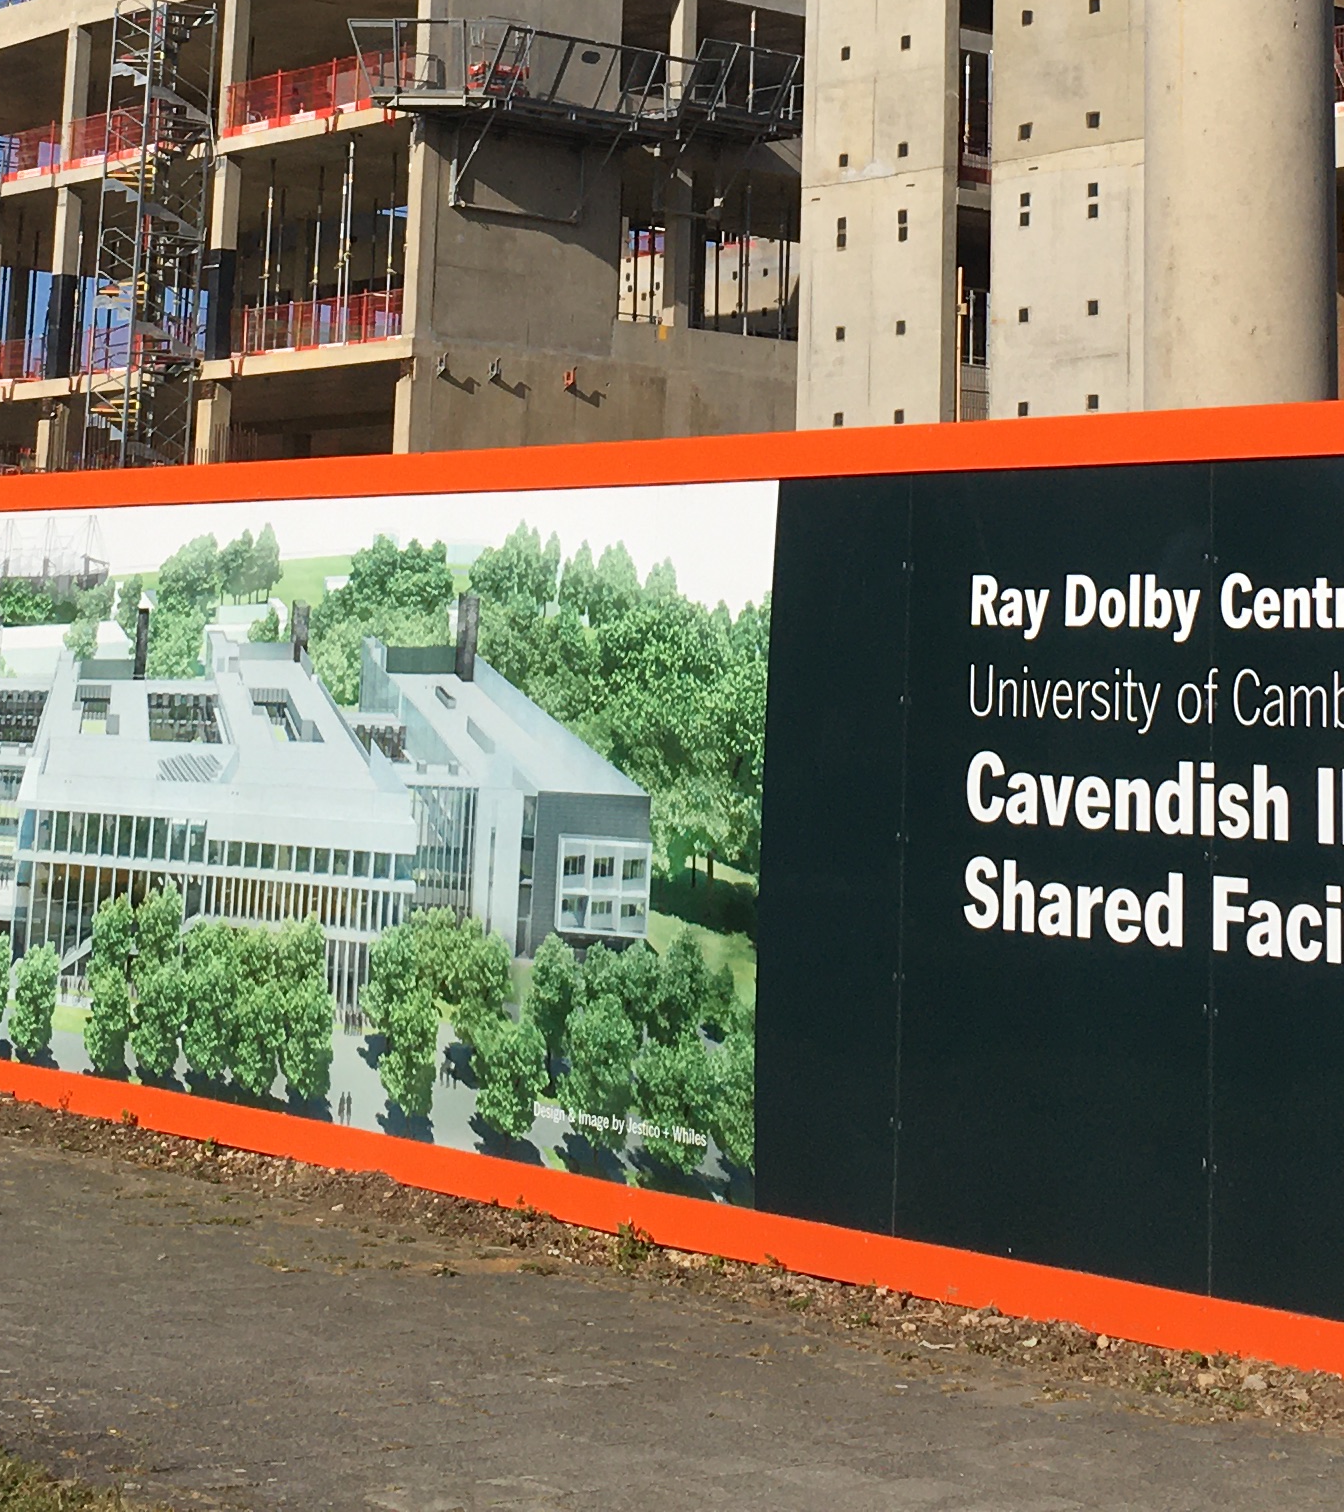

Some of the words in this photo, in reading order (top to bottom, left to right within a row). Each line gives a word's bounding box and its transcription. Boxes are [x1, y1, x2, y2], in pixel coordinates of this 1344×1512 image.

[971, 574, 1050, 640] Ray
[1064, 573, 1201, 643] Dolby
[969, 663, 1161, 735] University
[1177, 667, 1219, 724] of
[966, 750, 1289, 842] Cavendish
[963, 855, 1184, 948] Shared
